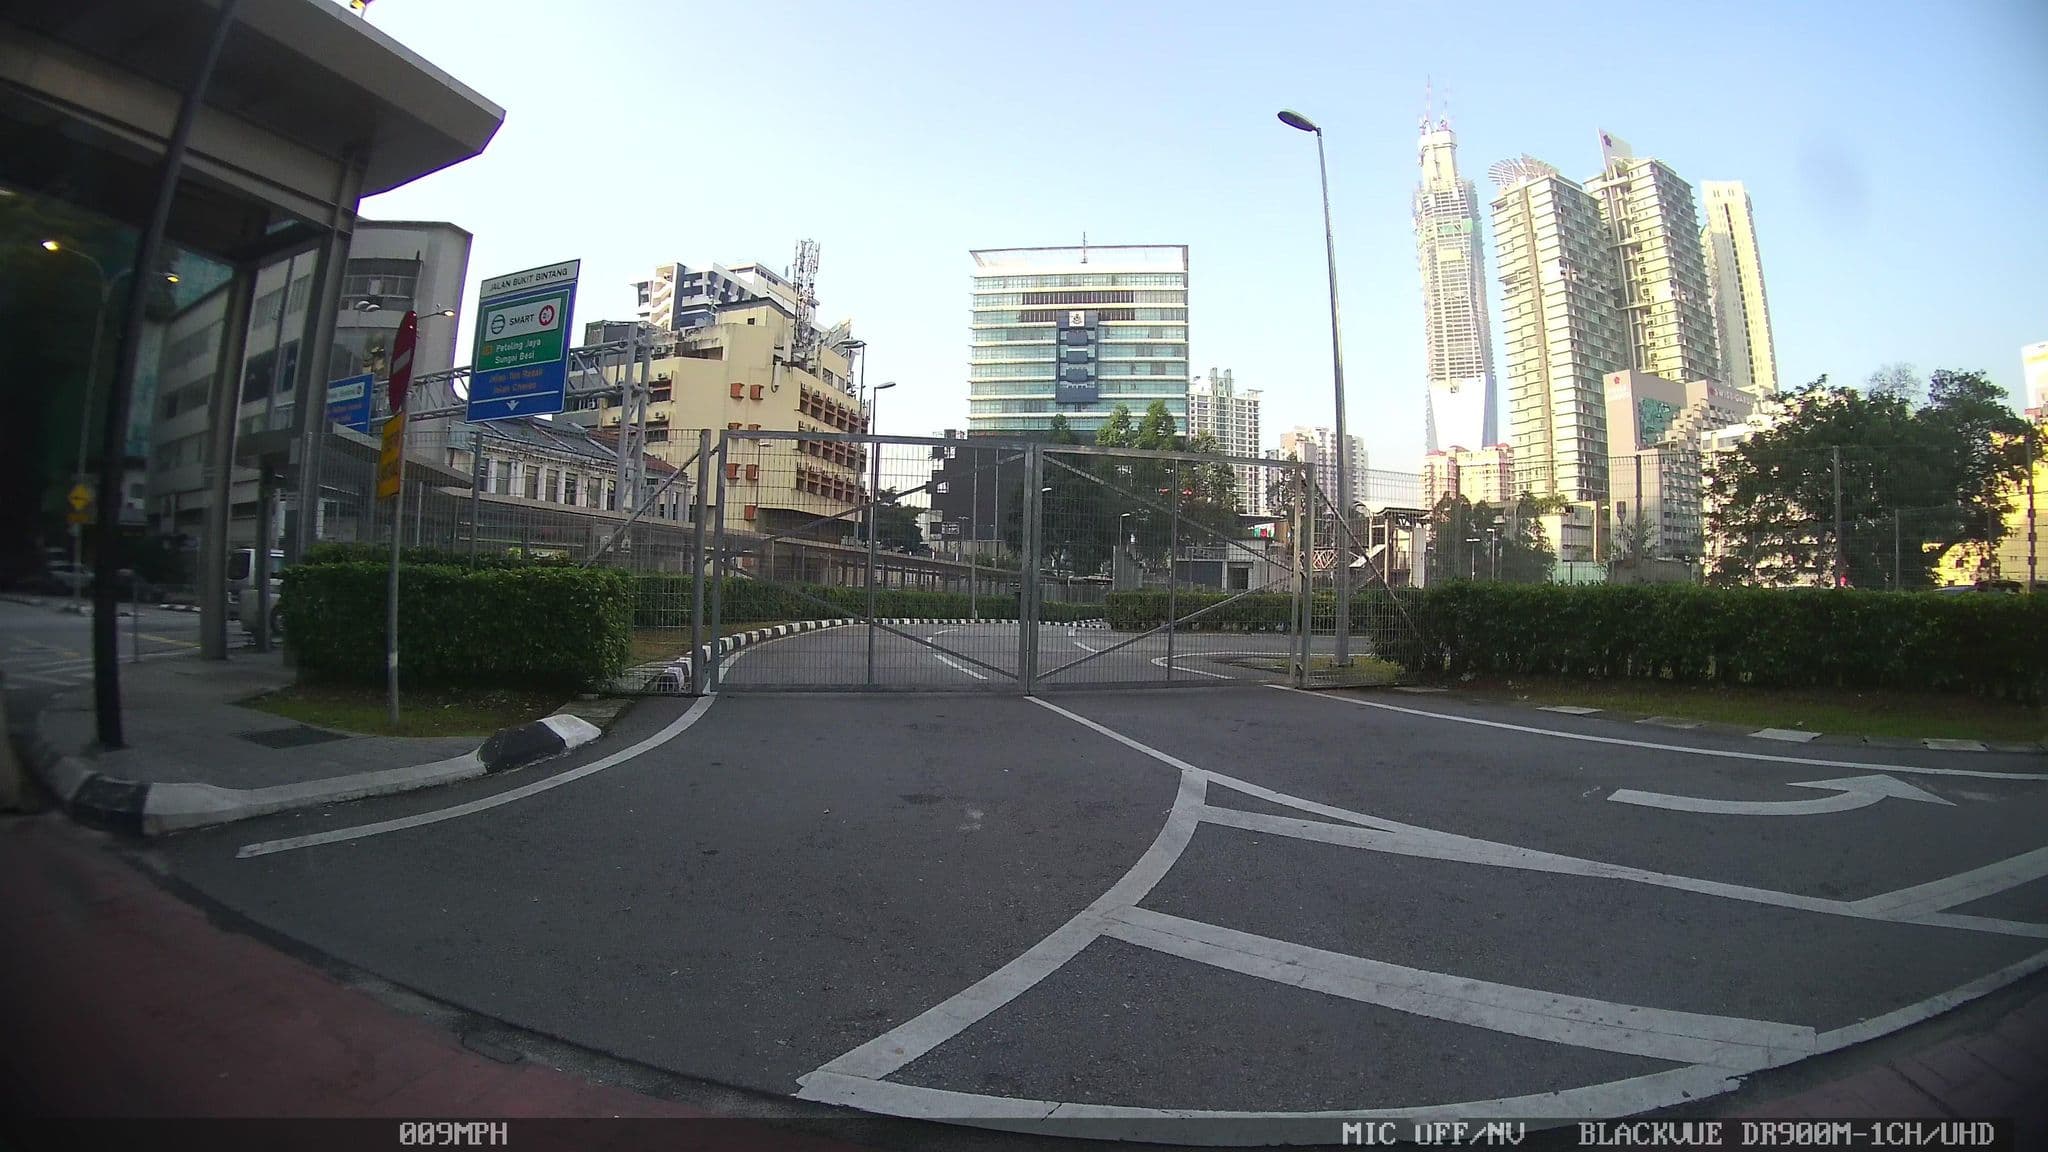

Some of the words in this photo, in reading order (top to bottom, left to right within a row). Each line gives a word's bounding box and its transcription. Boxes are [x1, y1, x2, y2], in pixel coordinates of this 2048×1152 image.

[490, 279, 511, 291] JALAN
[513, 275, 533, 286] BUKIT
[536, 268, 568, 281] BINTANG
[509, 314, 535, 325] SMART
[526, 338, 541, 349] Jaya
